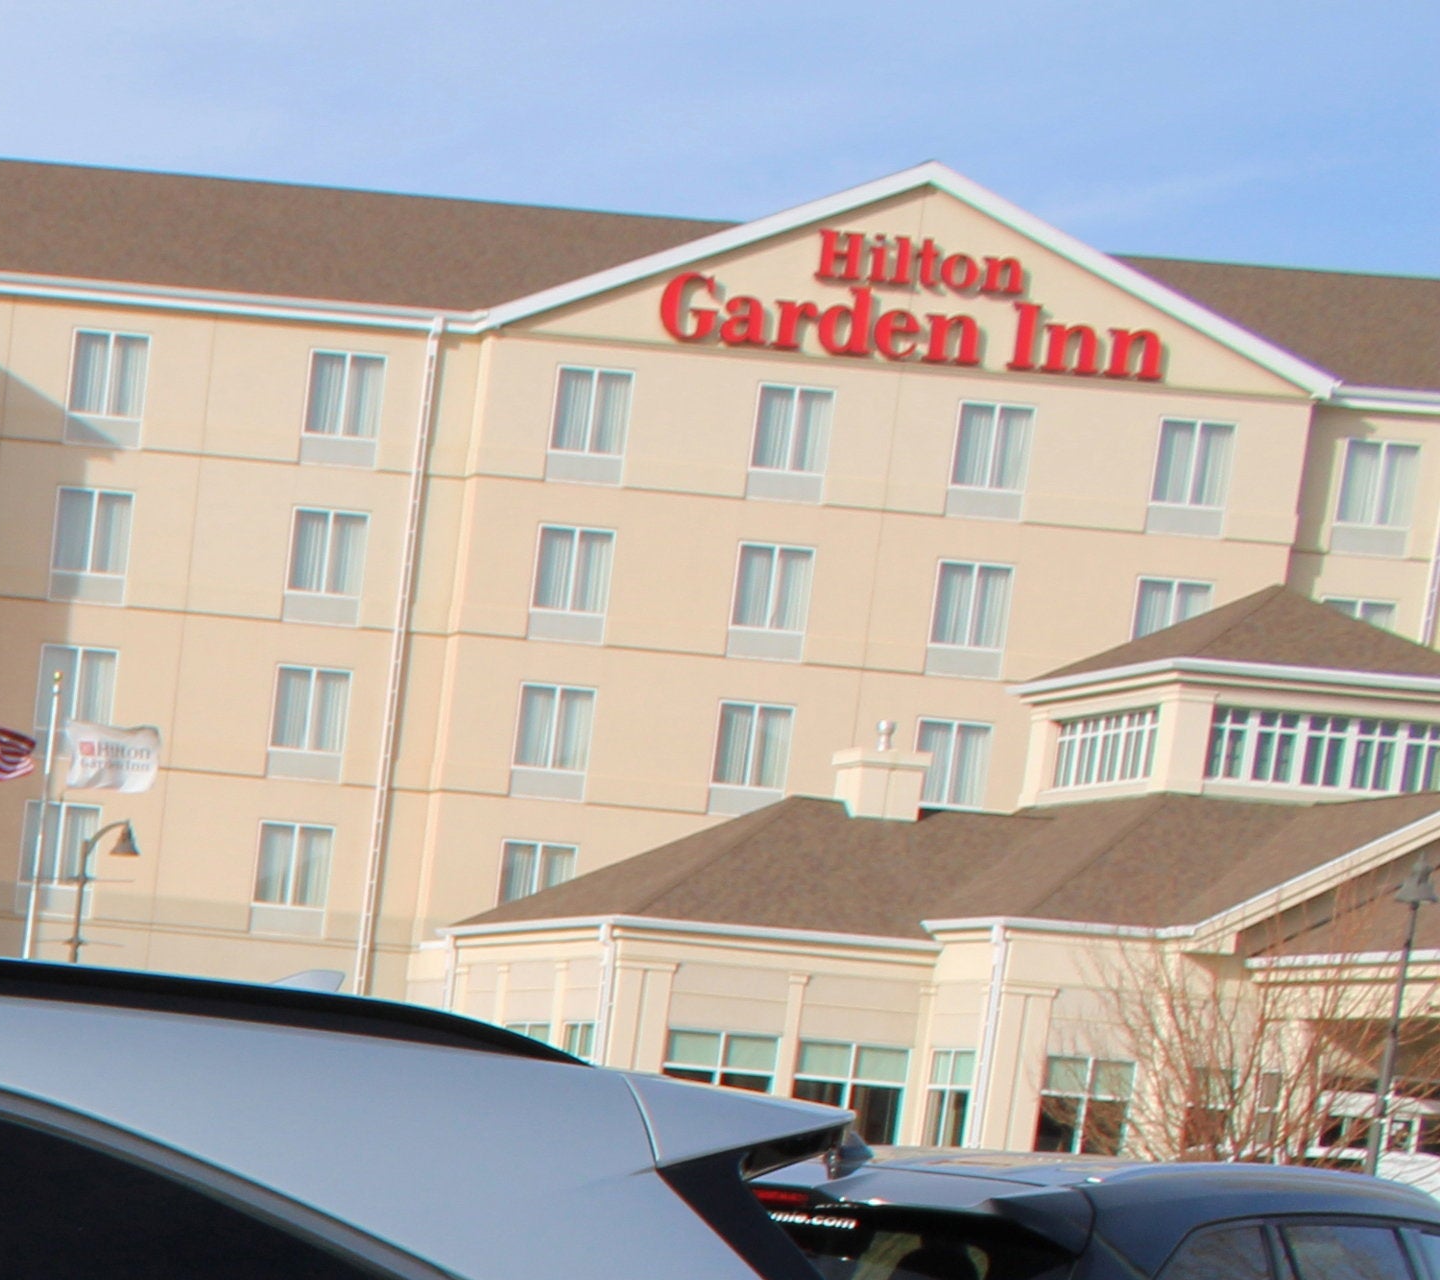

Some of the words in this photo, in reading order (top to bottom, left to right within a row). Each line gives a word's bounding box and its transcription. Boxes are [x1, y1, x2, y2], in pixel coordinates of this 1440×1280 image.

[814, 229, 1025, 295] Hilton
[659, 271, 982, 366] Garden
[1006, 302, 1165, 382] Inn
